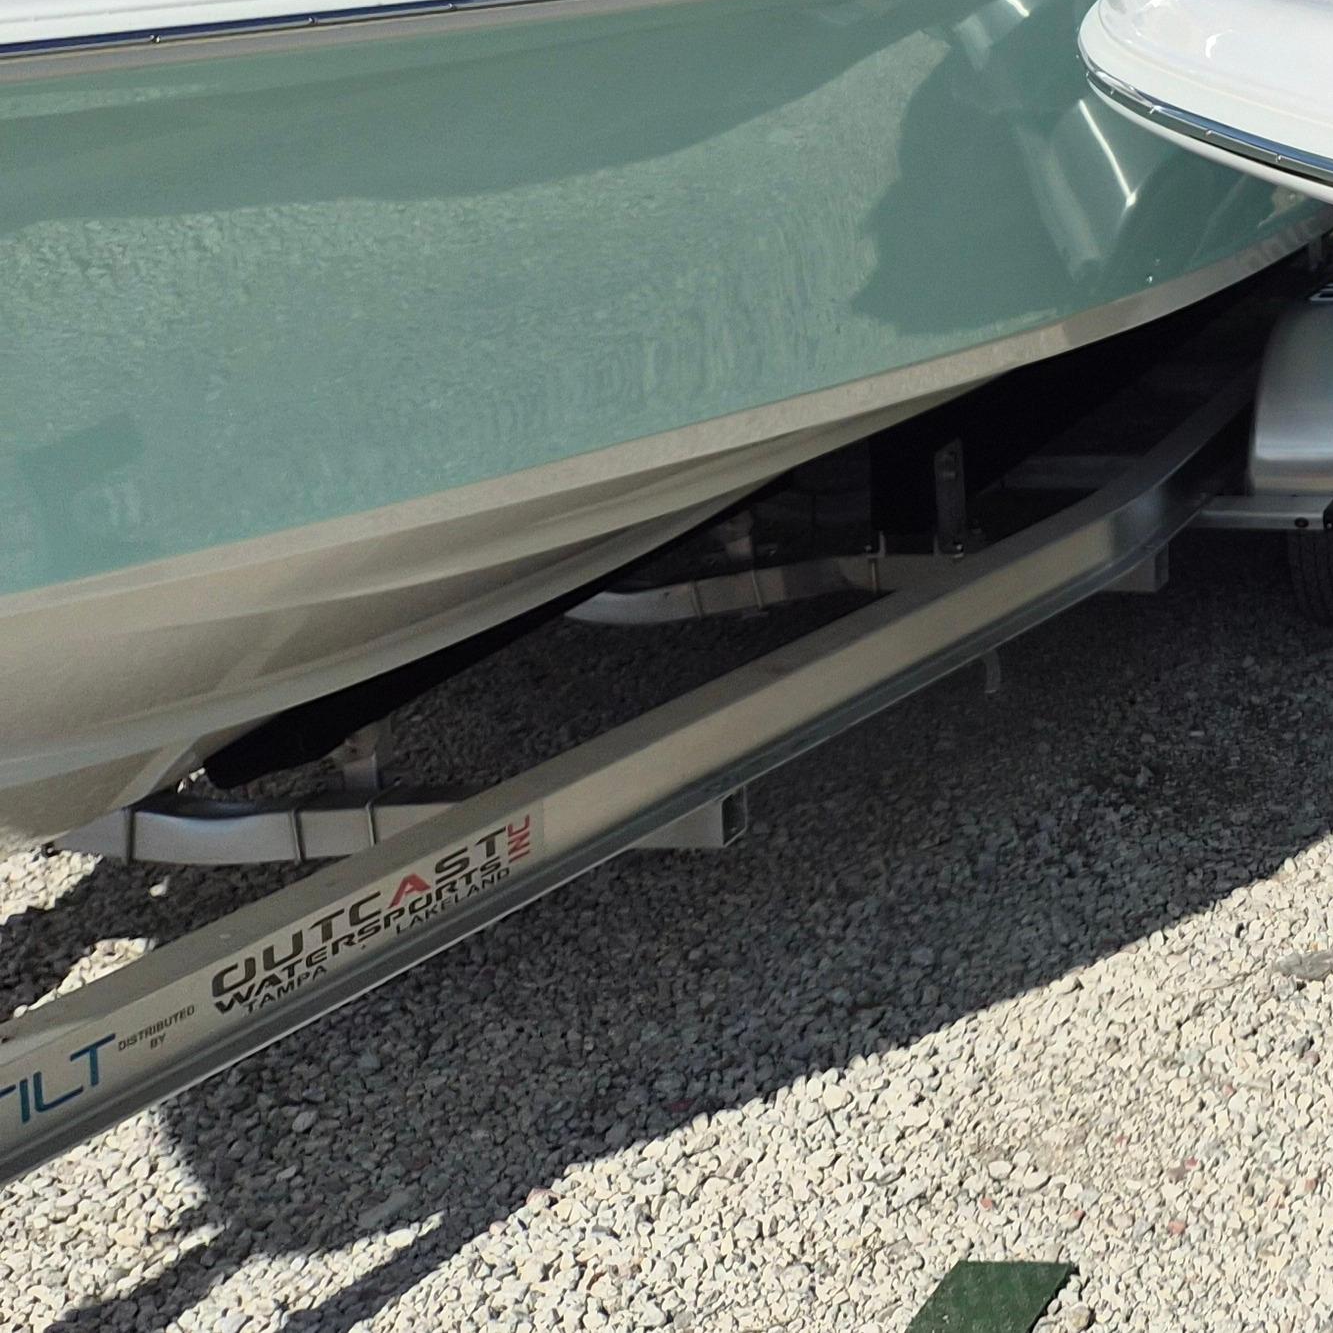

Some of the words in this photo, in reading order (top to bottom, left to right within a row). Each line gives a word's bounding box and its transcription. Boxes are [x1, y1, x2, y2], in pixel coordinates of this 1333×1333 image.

[507, 814, 532, 863] INC
[211, 825, 507, 998] OUTCAST
[213, 856, 502, 1015] WATERSPORTS
[246, 964, 328, 1014] TAMPA
[395, 866, 511, 935] LAKELAND
[118, 1005, 195, 1052] DISTRIBUTED
[150, 1033, 167, 1049] BY
